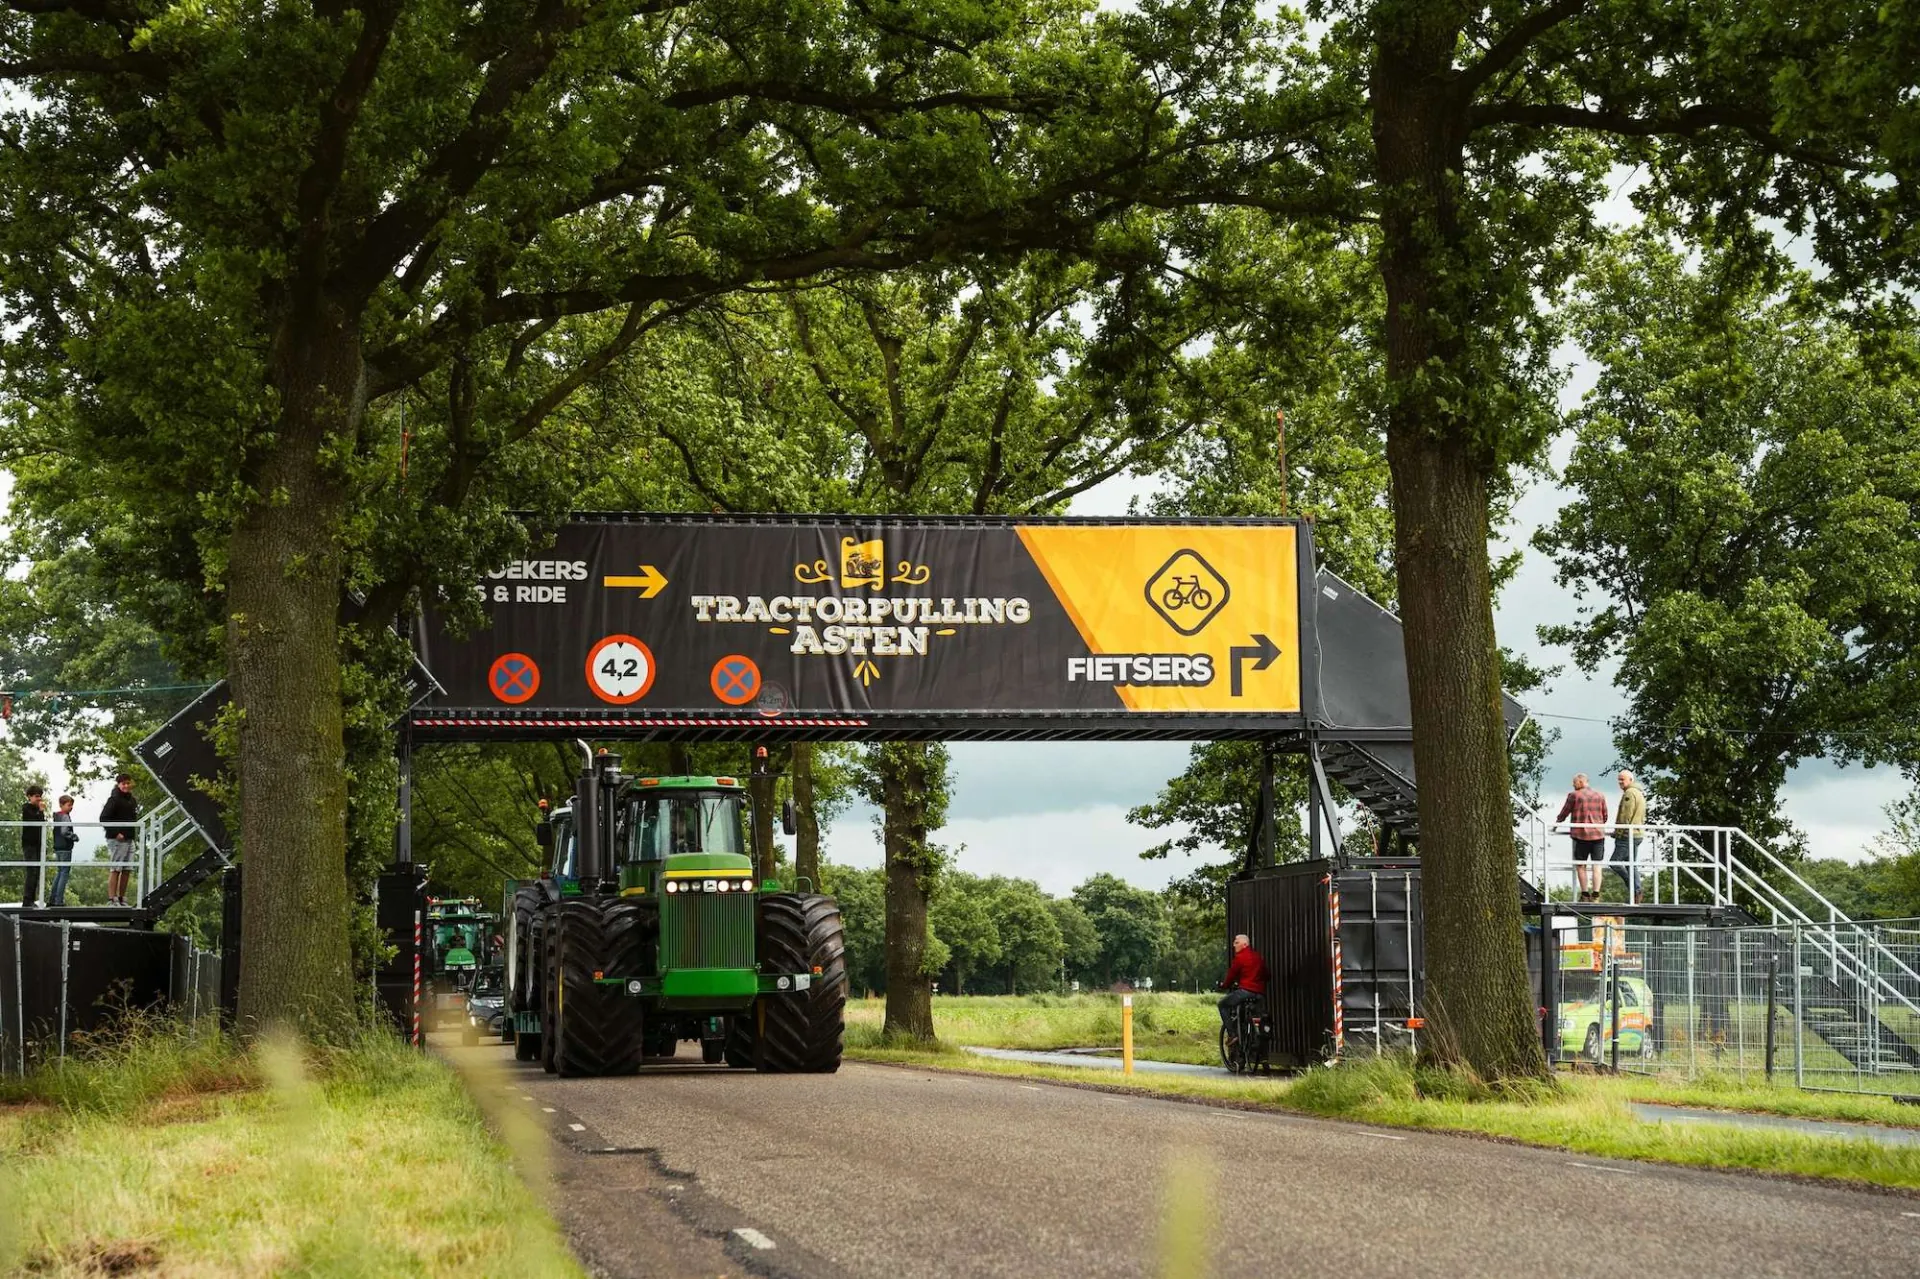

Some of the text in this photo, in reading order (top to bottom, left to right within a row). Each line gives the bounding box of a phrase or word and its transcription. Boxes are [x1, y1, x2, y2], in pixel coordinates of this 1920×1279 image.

[493, 585, 509, 603] &
[516, 585, 567, 603] RIDE
[690, 595, 1031, 625] TRACTORPULLING
[790, 626, 930, 656] ASTEN
[601, 658, 638, 681] 4,2
[1066, 656, 1213, 683] FIETSERS
